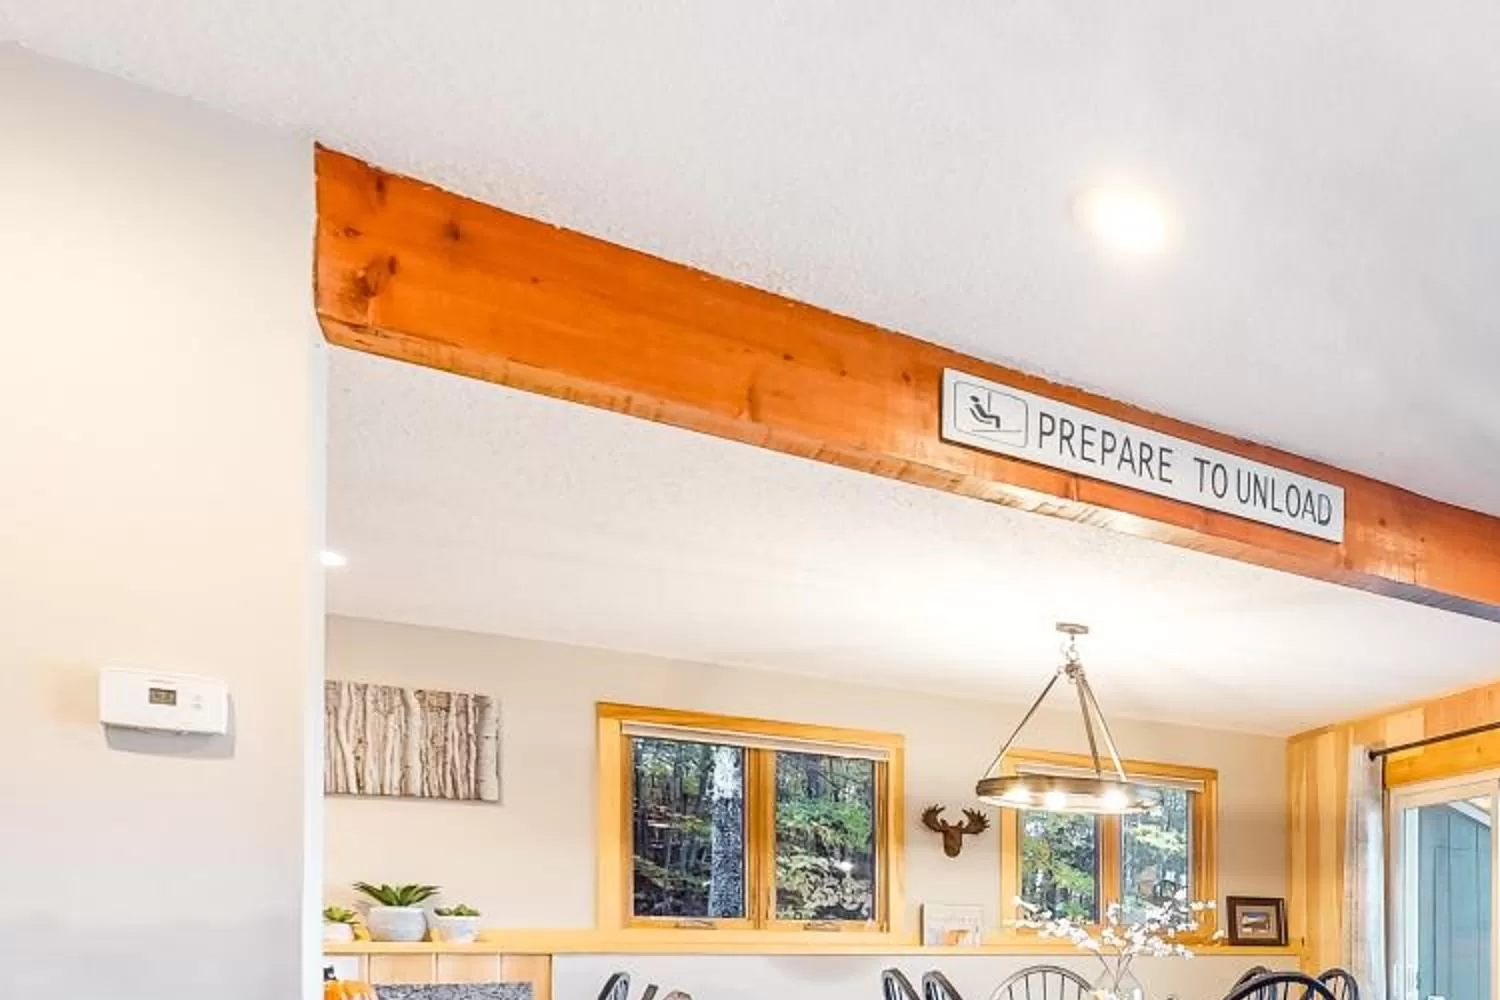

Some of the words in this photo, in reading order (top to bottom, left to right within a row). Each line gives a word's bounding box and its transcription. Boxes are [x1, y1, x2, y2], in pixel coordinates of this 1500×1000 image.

[1038, 411, 1174, 484] PREPARE
[1193, 456, 1229, 499] TO
[1236, 468, 1332, 527] UNLOAD
